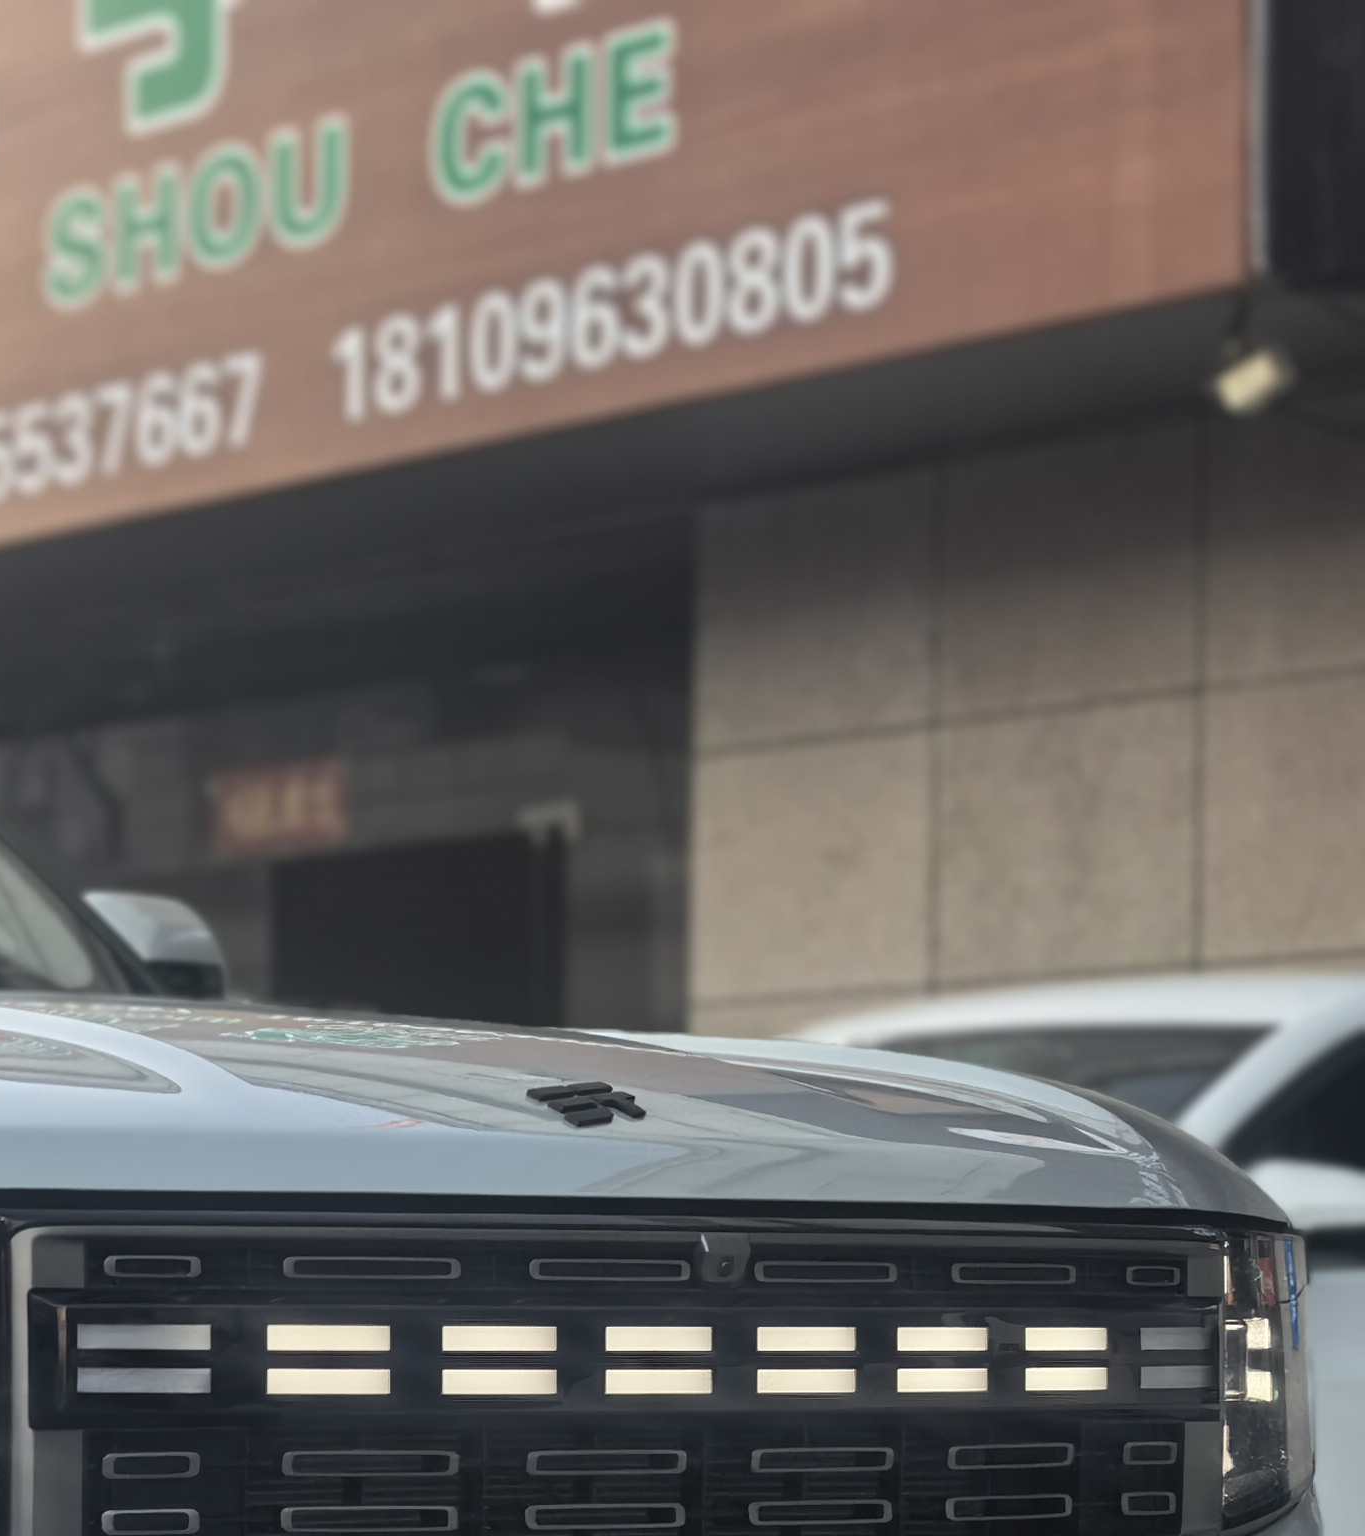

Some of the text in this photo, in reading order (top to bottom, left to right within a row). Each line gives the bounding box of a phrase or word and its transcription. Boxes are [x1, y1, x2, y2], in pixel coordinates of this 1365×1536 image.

[43, 112, 352, 309] SHOU
[430, 20, 675, 206] CHE
[332, 199, 893, 423] 18109630805
